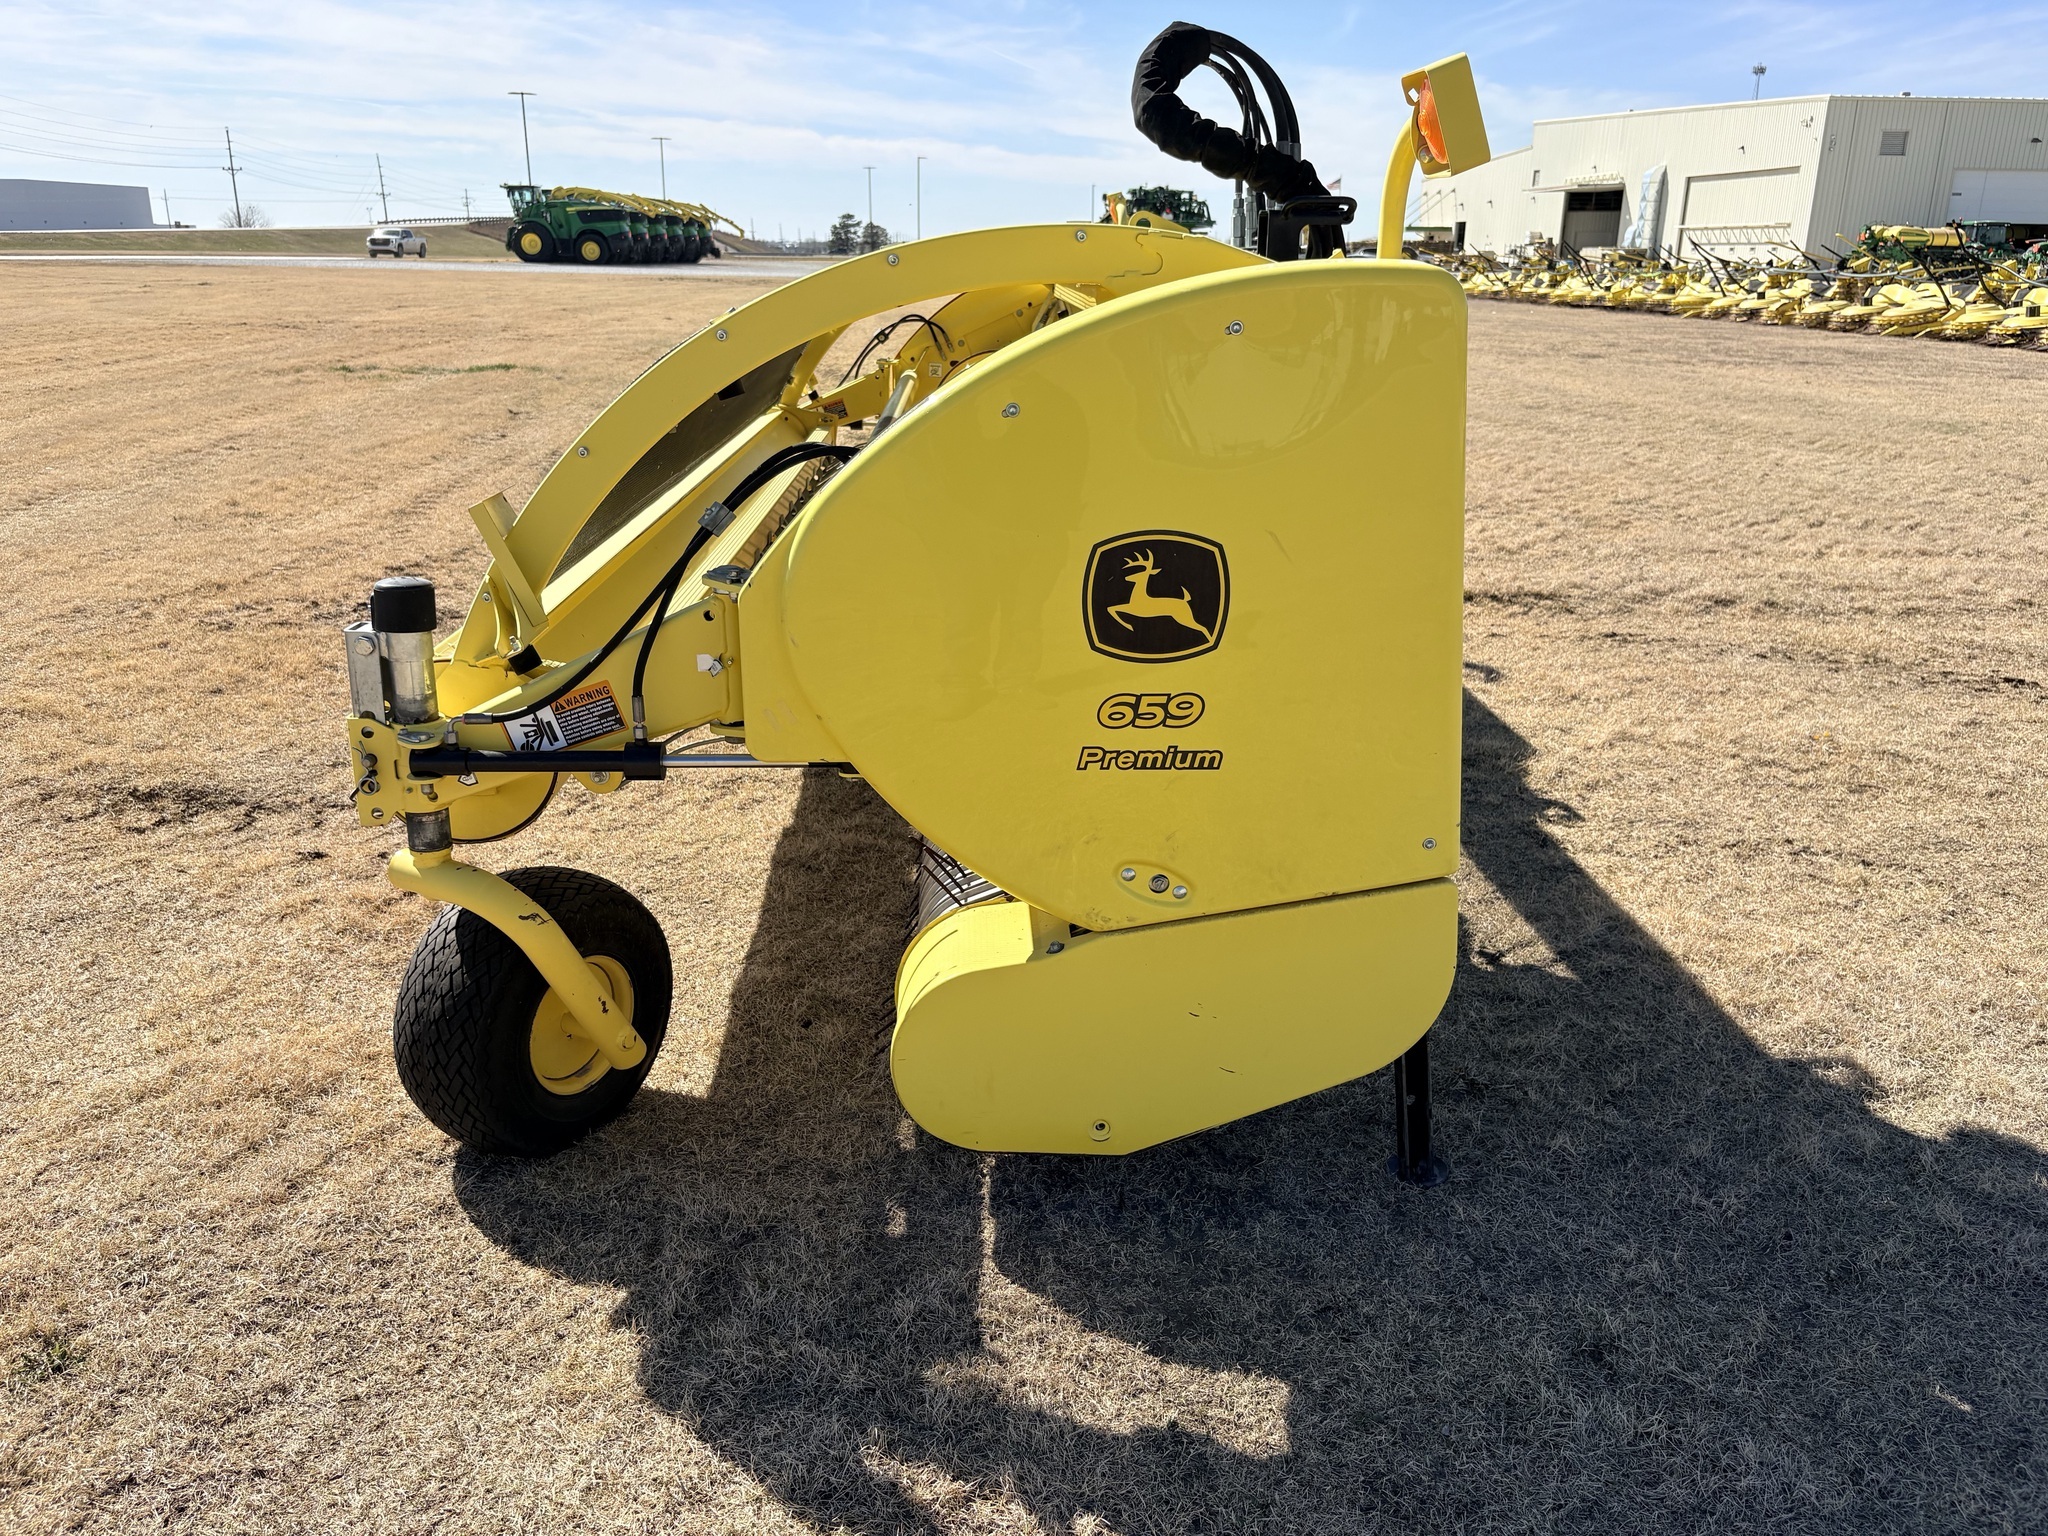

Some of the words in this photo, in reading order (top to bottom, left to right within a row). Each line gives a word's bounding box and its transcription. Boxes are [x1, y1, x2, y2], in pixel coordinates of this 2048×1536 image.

[564, 686, 610, 707] WARNING
[1097, 692, 1205, 729] 659
[1076, 745, 1223, 770] Premium
